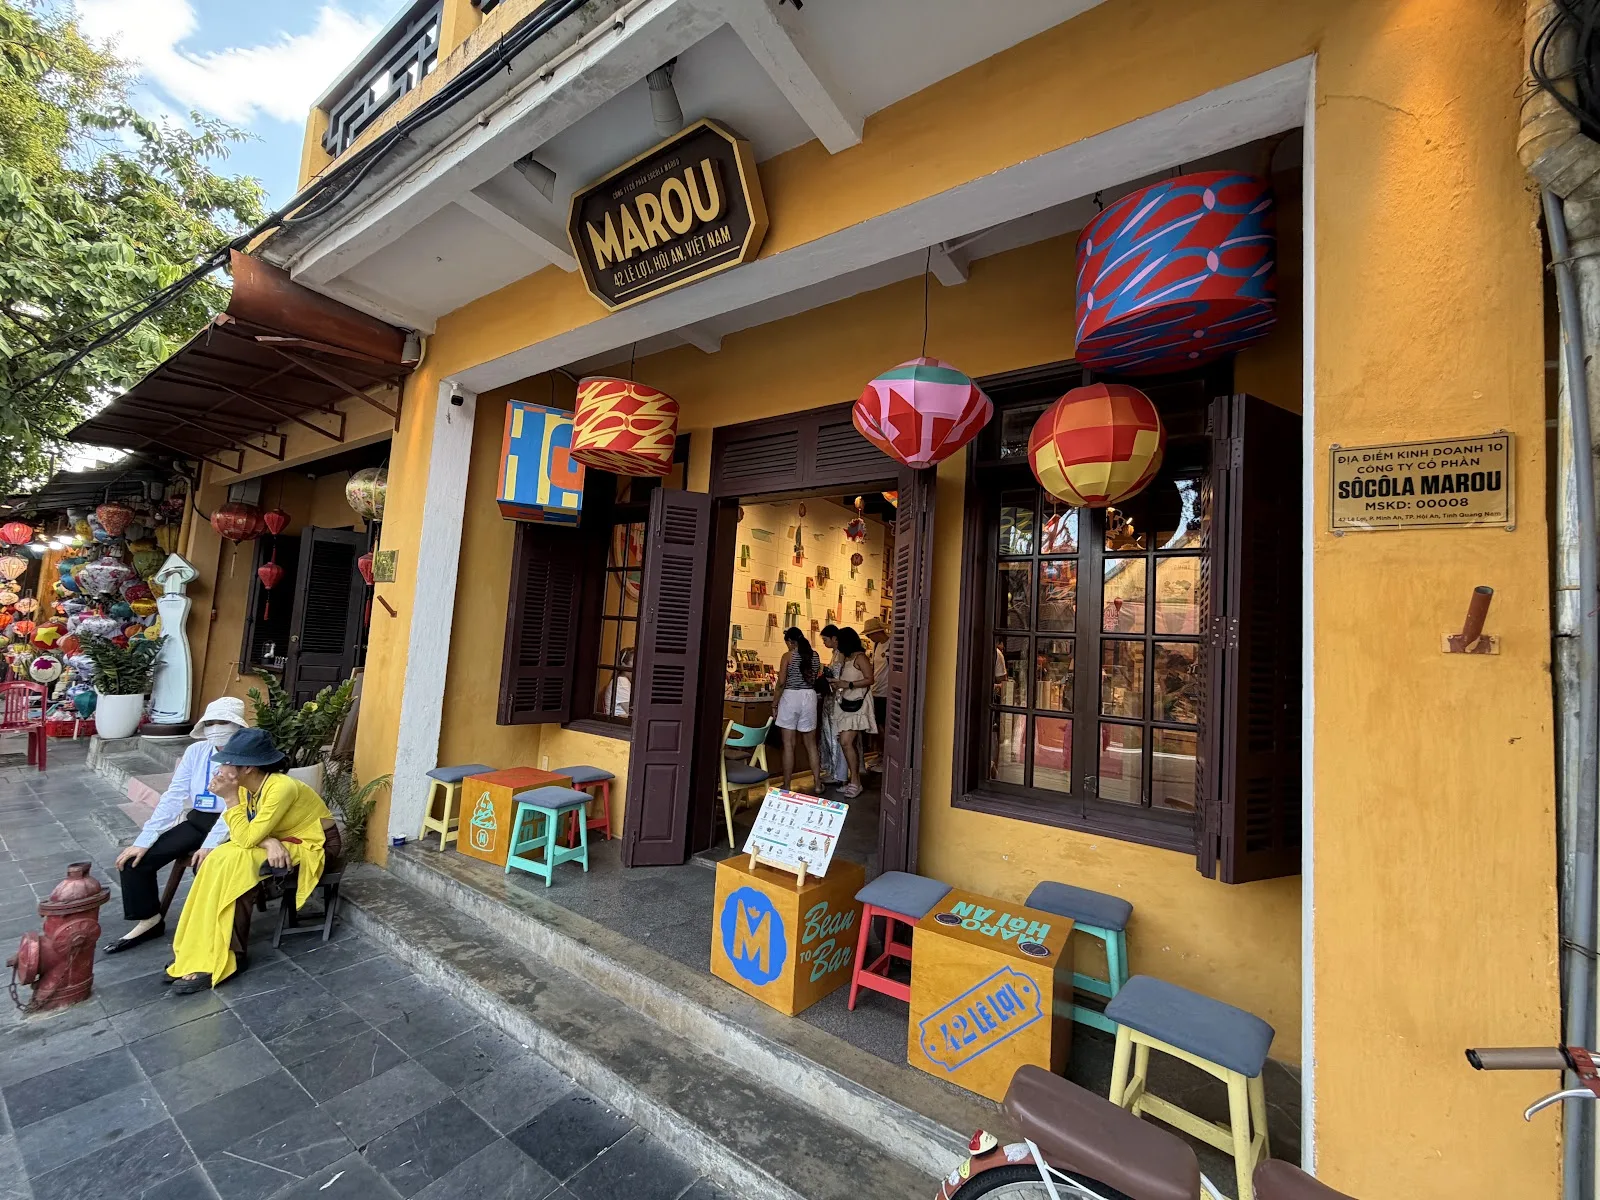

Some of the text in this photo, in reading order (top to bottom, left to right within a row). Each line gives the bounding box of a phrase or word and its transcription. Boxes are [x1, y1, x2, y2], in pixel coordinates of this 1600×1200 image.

[586, 158, 720, 271] MAROU
[613, 224, 732, 288] 42 LÊ LỢI, HỘI AN, VIỆT NAM
[1338, 456, 1359, 465] ĐỊA
[1397, 449, 1429, 460] KINH
[1433, 444, 1484, 456] DOANH
[1488, 443, 1503, 452] 10
[1357, 464, 1394, 474] CÔNG
[1397, 462, 1414, 471] TY
[1418, 458, 1437, 470] CỔ
[1338, 470, 1502, 499] SÔCÔLA MAROU
[1365, 498, 1469, 511] MSKD: 00008
[802, 901, 855, 945] Bean
[950, 901, 996, 922] AN
[996, 912, 1052, 940] HỘI
[733, 898, 771, 975] M
[960, 918, 1045, 946] MARO
[810, 938, 853, 983] Bar
[940, 1014, 978, 1052] 42
[967, 1001, 998, 1034] LÊ
